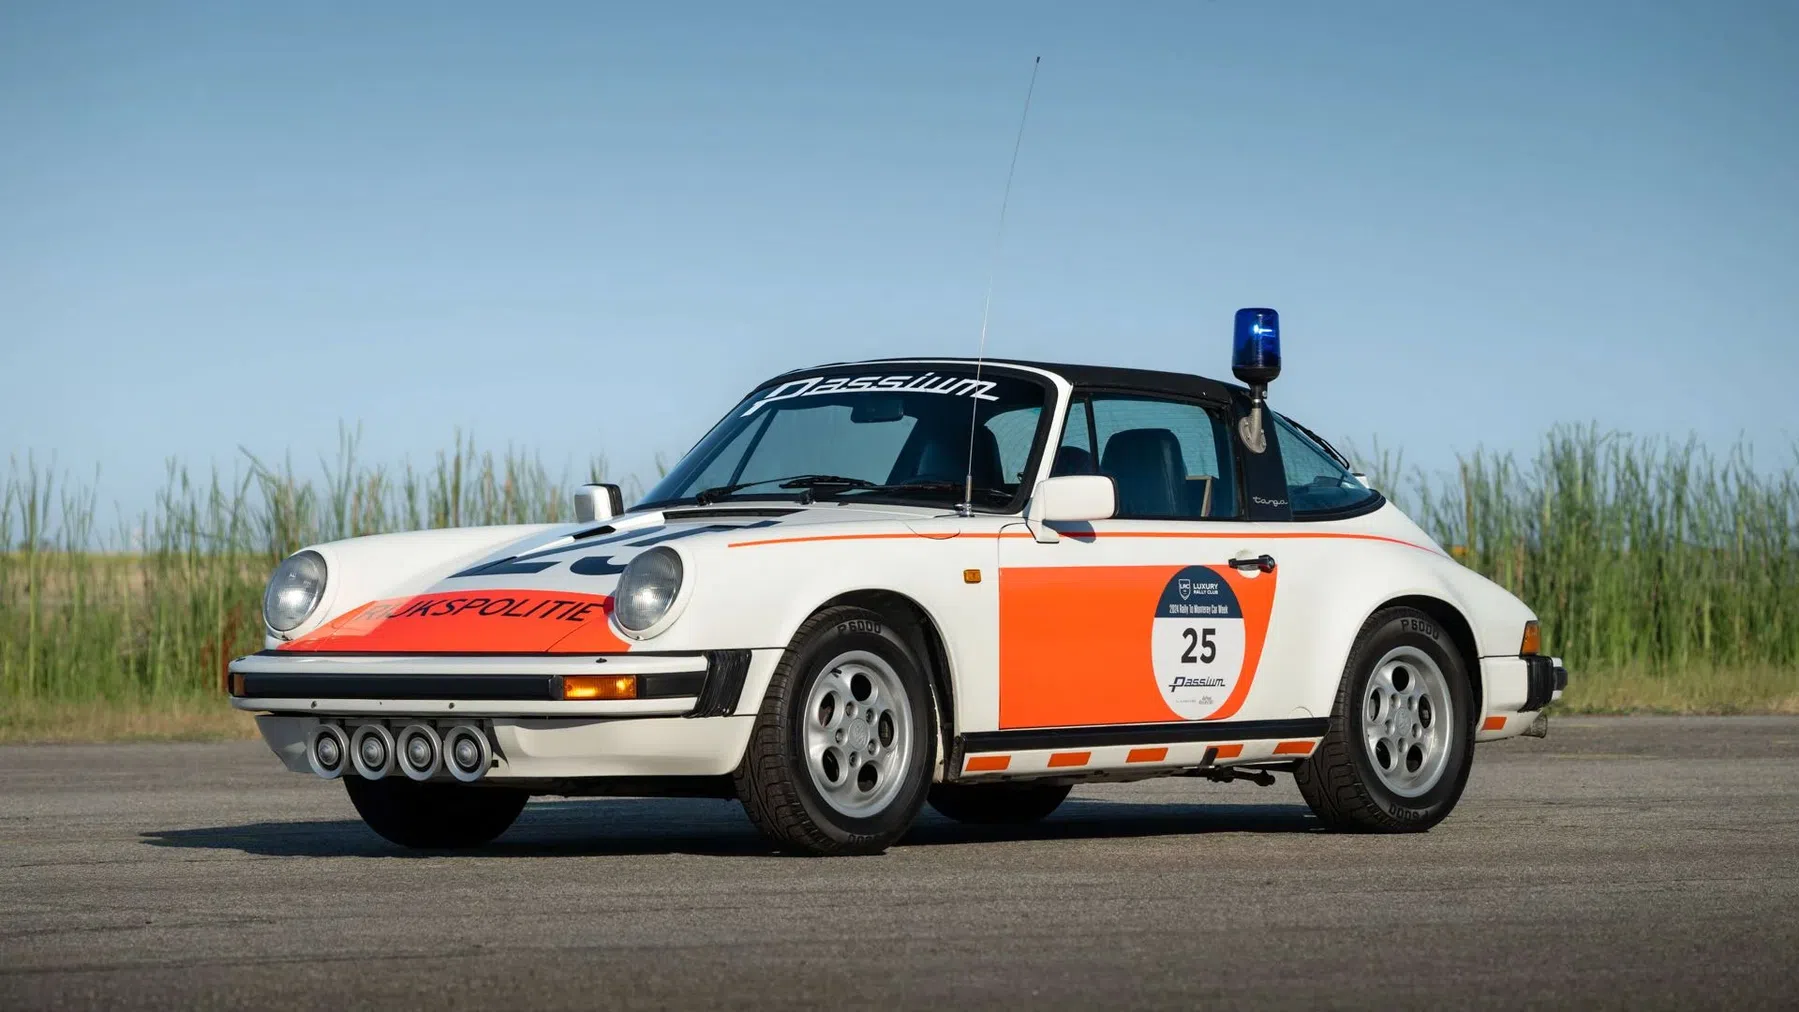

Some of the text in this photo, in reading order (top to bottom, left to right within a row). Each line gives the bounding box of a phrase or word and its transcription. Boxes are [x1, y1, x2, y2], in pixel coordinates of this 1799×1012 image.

[740, 372, 999, 417] Passium
[1253, 496, 1288, 507] targa
[354, 598, 604, 621] RIJKSPOLITIE
[1169, 604, 1179, 614] 2024
[1179, 604, 1188, 615] Rally
[1194, 604, 1211, 615] Monterey
[1218, 604, 1228, 614] Week
[1181, 627, 1216, 664] 25
[1168, 676, 1226, 693] Passium
